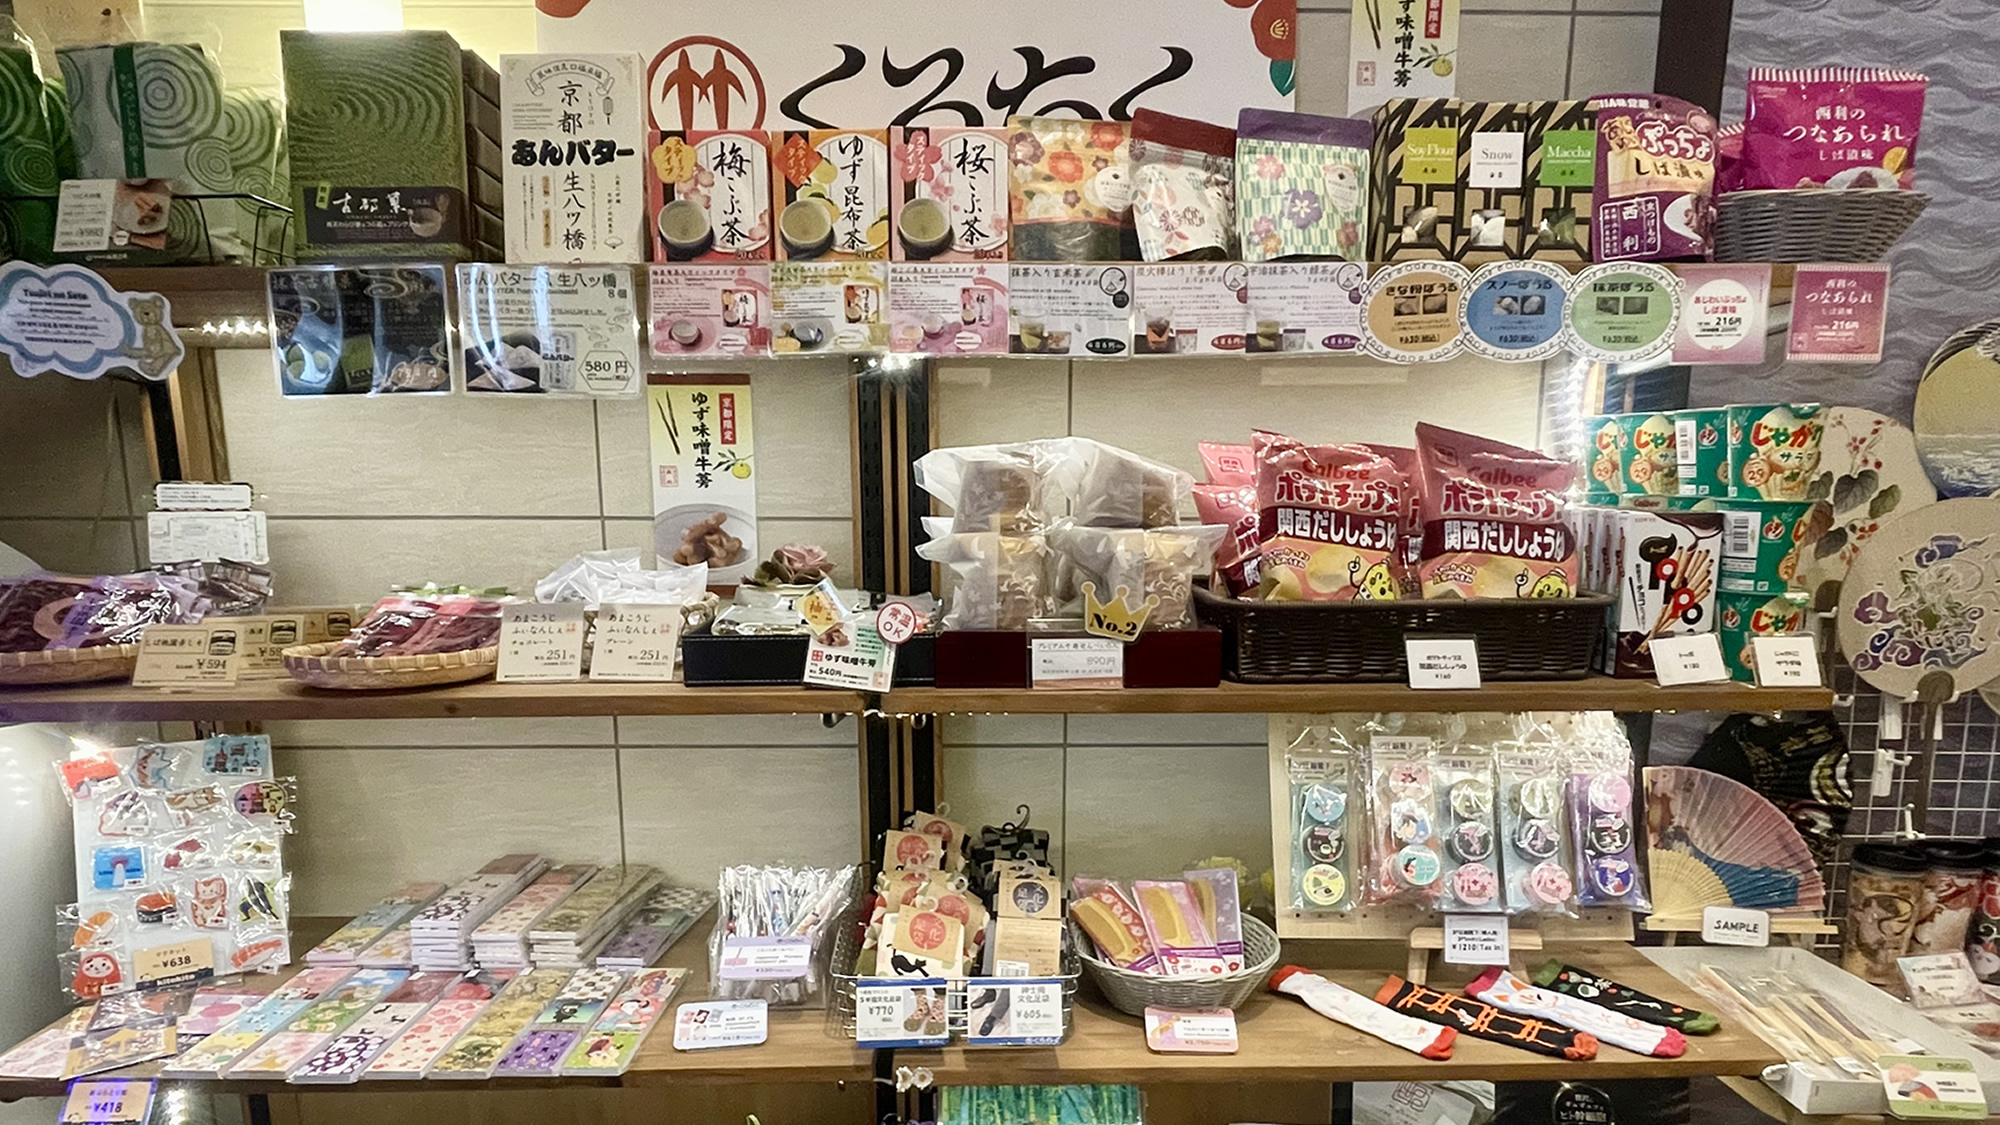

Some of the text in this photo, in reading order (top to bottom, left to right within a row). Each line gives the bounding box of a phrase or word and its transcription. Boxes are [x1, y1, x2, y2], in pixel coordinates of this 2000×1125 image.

[558, 80, 583, 135] 京都
[1815, 105, 1866, 121] 西利の
[1641, 122, 1712, 160] ぷっちょ
[1783, 124, 1906, 144] つなあられ
[511, 139, 635, 167] あんバター
[1481, 147, 1514, 160] Snow
[1546, 145, 1592, 158] Maccha
[711, 141, 751, 246] 梅こぶ茶
[838, 135, 868, 250] ゆず昆布茶
[953, 138, 994, 245] 桜こぶ茶
[1621, 203, 1641, 252] 西利
[691, 391, 713, 489] ゆず味噌牛蒡
[1303, 460, 1370, 480] Calbee
[1467, 466, 1537, 488] Calbee
[513, 613, 556, 623] あまこうじ
[608, 613, 651, 623] あまこうじ
[1089, 612, 1138, 636] No.2
[883, 621, 904, 638] OK
[1713, 919, 1760, 934] SAMPLE
[162, 955, 192, 968] ¥638
[868, 1005, 894, 1016] ¥770
[1016, 1009, 1041, 1019] ¥605
[94, 1102, 124, 1113] ¥418
